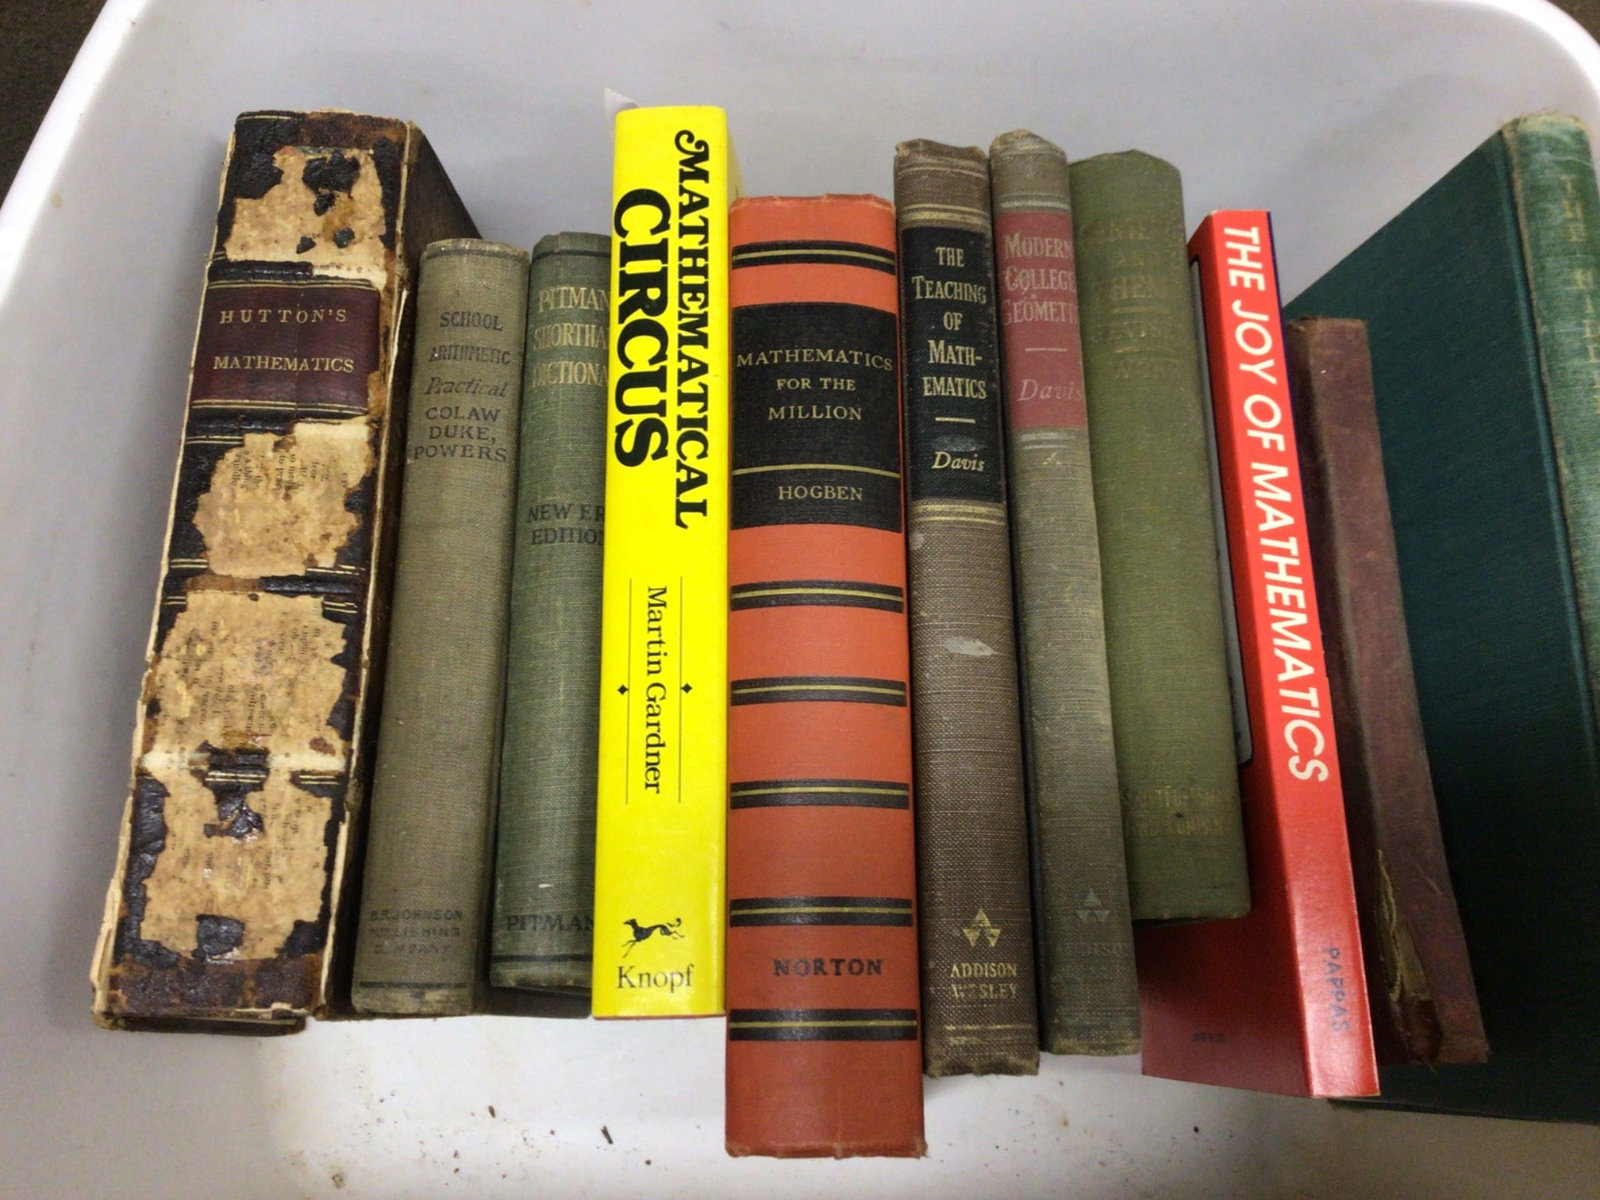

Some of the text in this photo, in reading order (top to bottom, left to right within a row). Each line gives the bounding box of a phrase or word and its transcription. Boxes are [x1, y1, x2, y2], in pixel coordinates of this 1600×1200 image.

[935, 246, 965, 268] THE
[911, 275, 987, 304] TEACHING
[219, 308, 348, 325] HUTTON'S
[439, 311, 504, 332] SCHOOL
[613, 188, 672, 467] CIRCUS
[942, 311, 963, 331] OF
[533, 322, 609, 350] SHORTHA
[674, 129, 710, 529] MATHEMATICAL
[213, 355, 355, 374] MATHEMATICS
[736, 347, 894, 372] MATHEMATICS
[928, 340, 983, 367] MATH-
[423, 376, 509, 398] Practical
[775, 377, 857, 391] FOR THE
[923, 376, 987, 400] EMATICS
[1016, 378, 1081, 402] Davis
[425, 406, 502, 423] COLAW
[767, 404, 863, 421] MILLION
[428, 424, 498, 446] DUKE,
[931, 450, 986, 473] Davis
[778, 485, 864, 502] HOGBEN
[527, 503, 573, 523] NEW
[1224, 226, 1330, 785] THE JOY OF MATHEMATICS
[643, 586, 668, 795] Martin Gardner
[616, 963, 696, 994] Knopf
[772, 958, 884, 977] NORTON
[950, 962, 1018, 979] ADDISON
[1321, 947, 1351, 1032] PAPPAS
